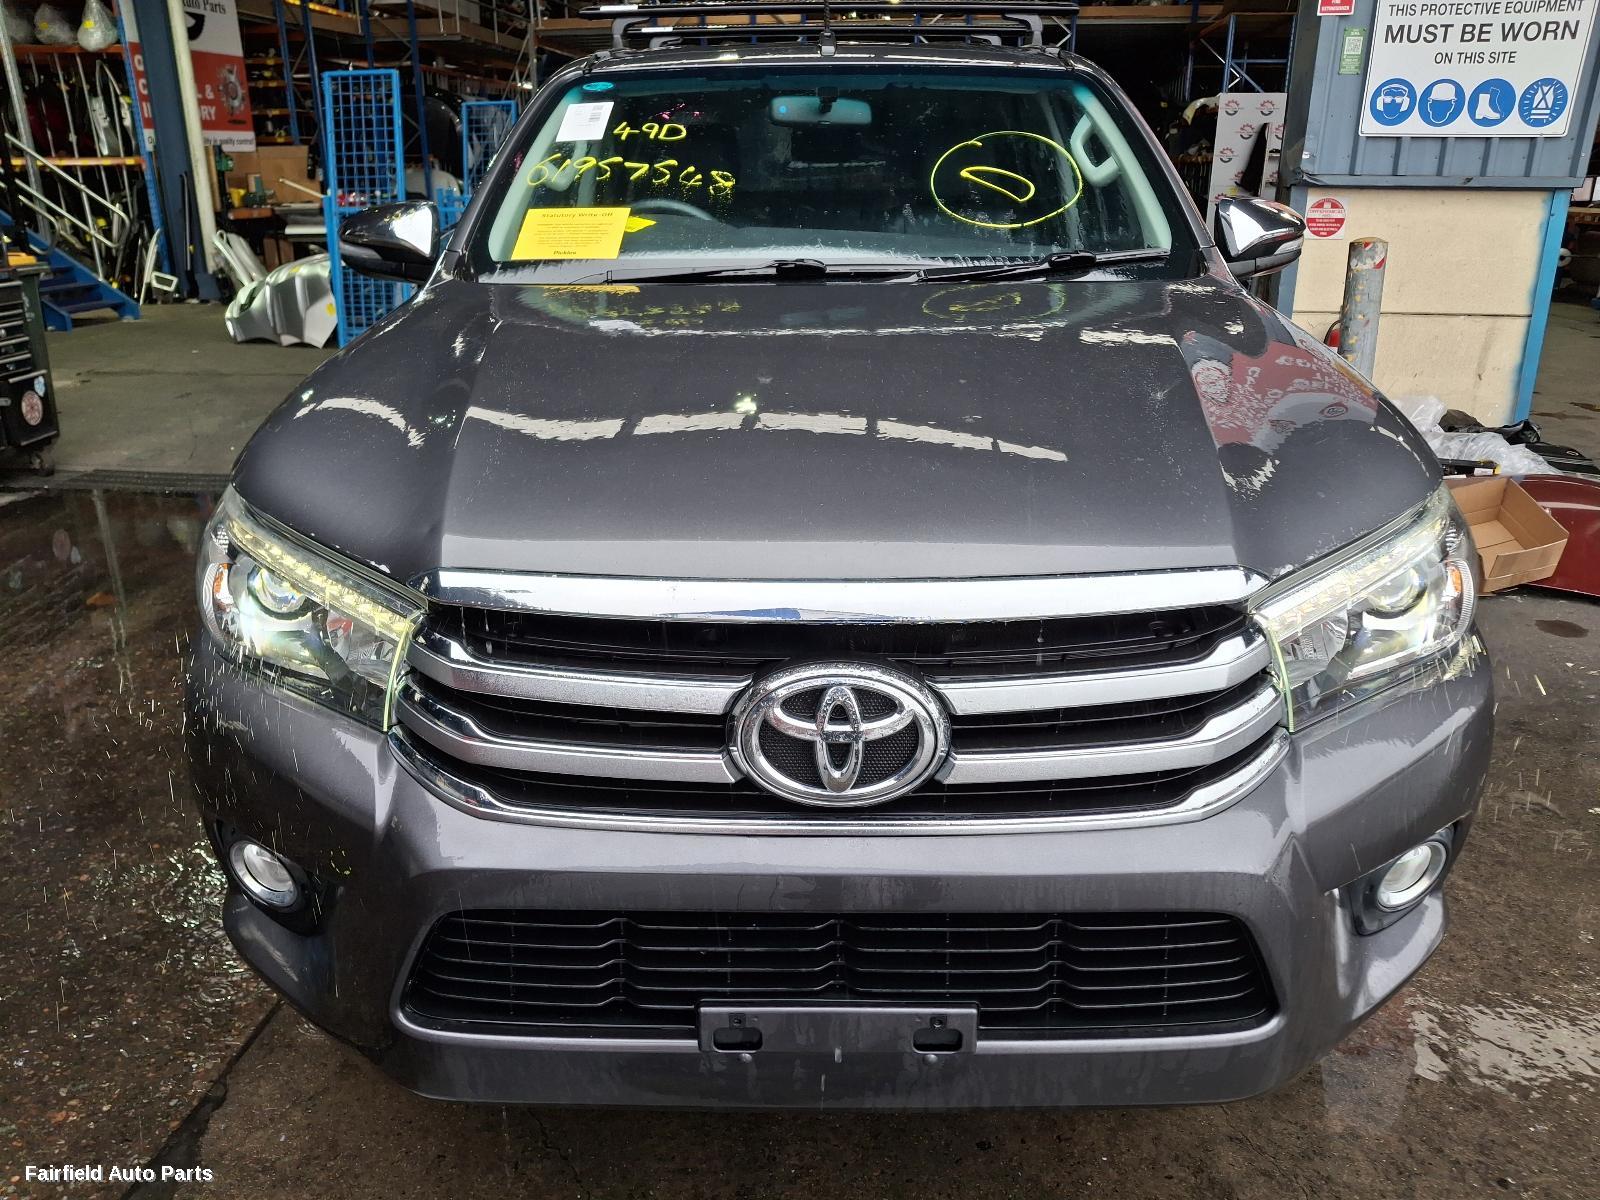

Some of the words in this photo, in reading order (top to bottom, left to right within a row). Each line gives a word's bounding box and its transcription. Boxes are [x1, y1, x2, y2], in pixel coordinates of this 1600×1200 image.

[203, 0, 226, 15] Parts
[1388, 4, 1417, 17] THIS
[1420, 1, 1501, 16] PROTECTIVE
[1504, 0, 1584, 14] EQUIPMENT
[1384, 23, 1454, 44] MUST
[1459, 22, 1494, 43] BE
[1501, 19, 1581, 42] WORN
[1434, 52, 1453, 65] ON
[1457, 51, 1485, 65] THIS
[1487, 51, 1518, 64] SITE
[612, 121, 687, 141] 49D
[526, 152, 736, 196] 61957548
